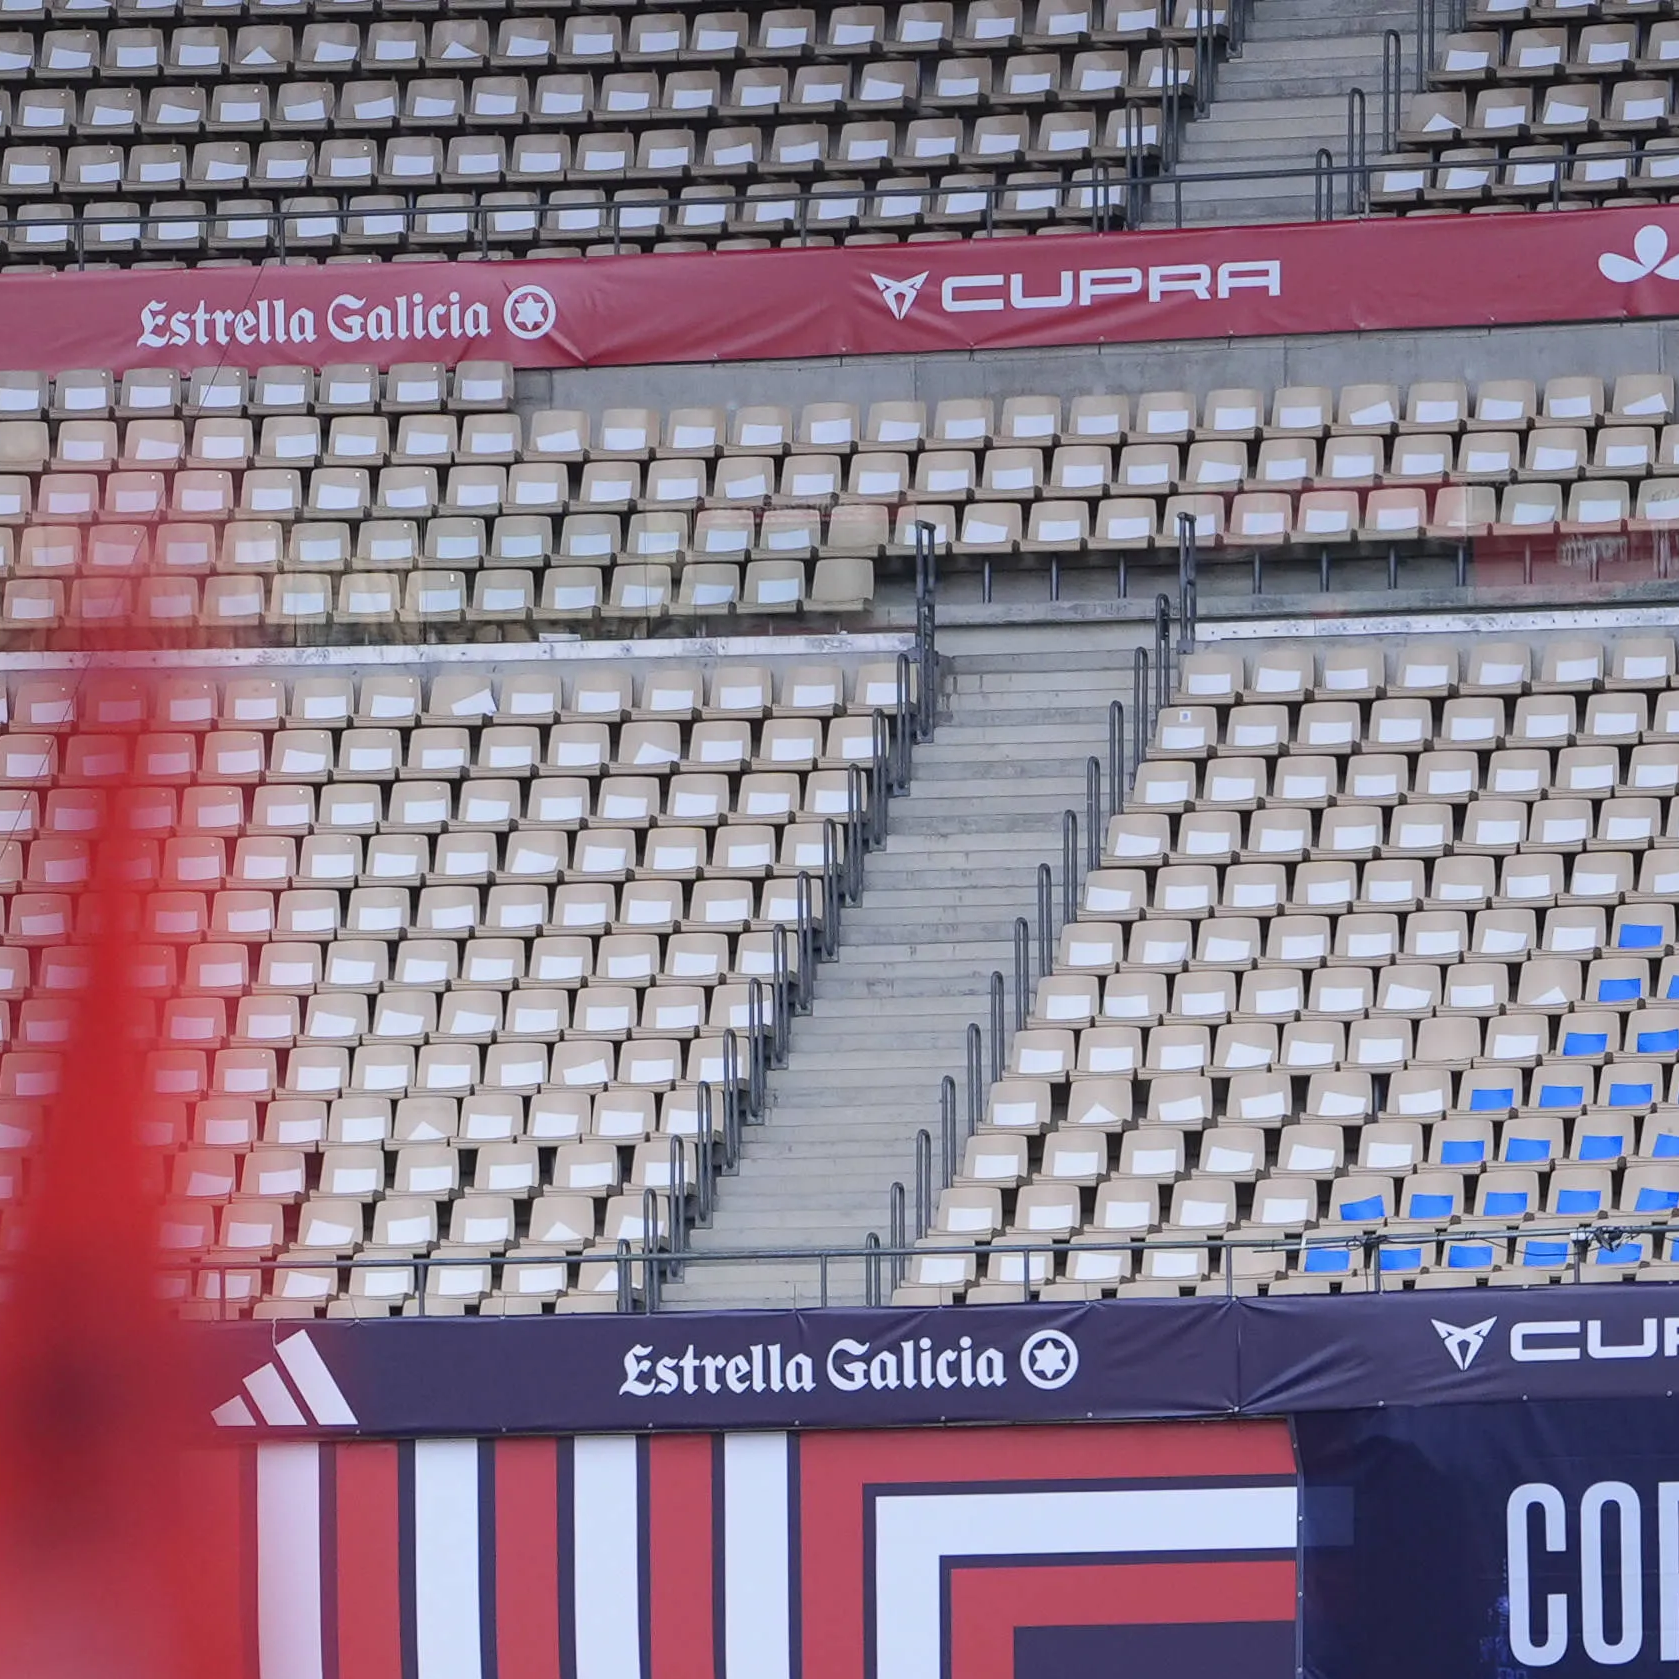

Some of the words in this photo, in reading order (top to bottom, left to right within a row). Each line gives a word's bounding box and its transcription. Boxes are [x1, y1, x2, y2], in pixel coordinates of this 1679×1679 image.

[941, 259, 1281, 313] CUPRA
[136, 298, 318, 348] Estrella
[326, 291, 492, 343] Galicia
[618, 1343, 817, 1396] Estrella
[826, 1335, 1008, 1391] Galicia
